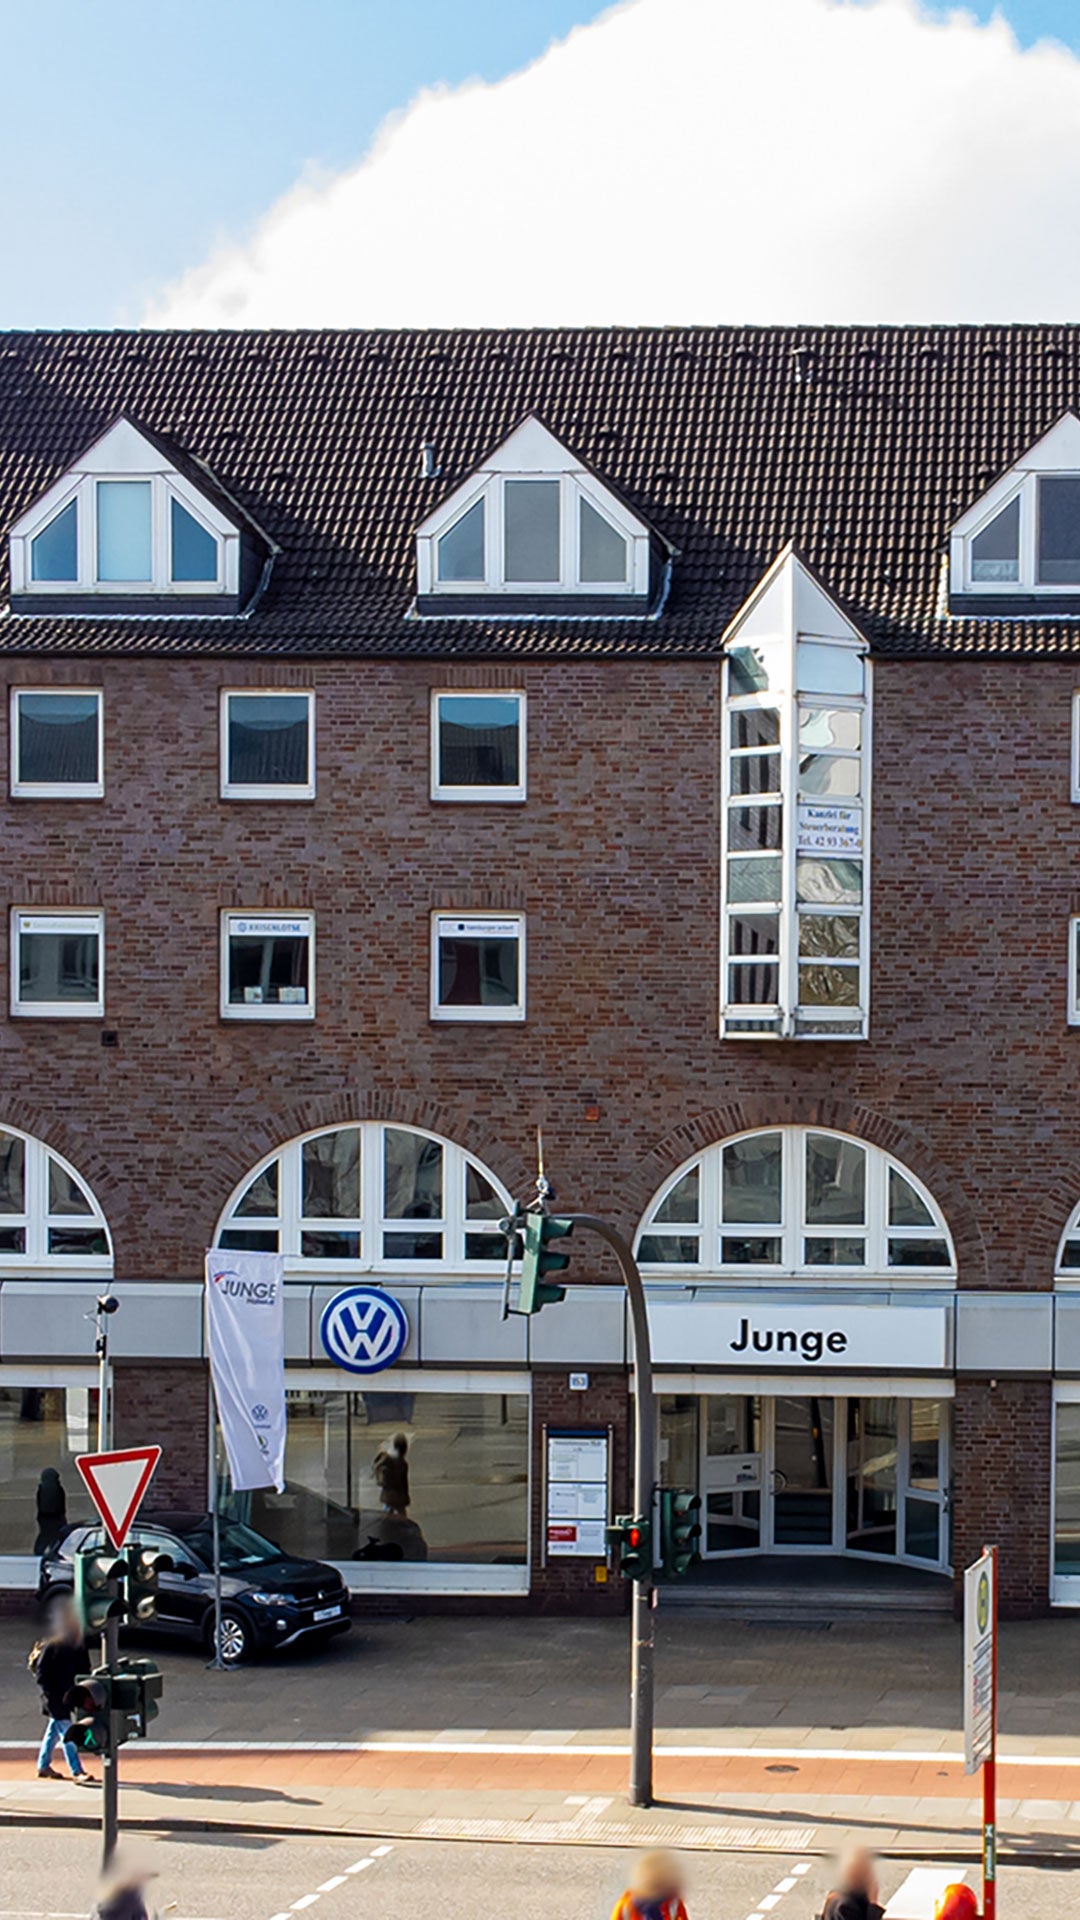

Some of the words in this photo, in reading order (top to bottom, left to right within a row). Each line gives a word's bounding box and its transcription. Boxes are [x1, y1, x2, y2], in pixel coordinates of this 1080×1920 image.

[807, 809, 838, 820] Kanzlei
[839, 810, 852, 820] für
[799, 821, 859, 836] Steuerberatung
[221, 1280, 276, 1299] JUNGE
[729, 1318, 848, 1362] Junge
